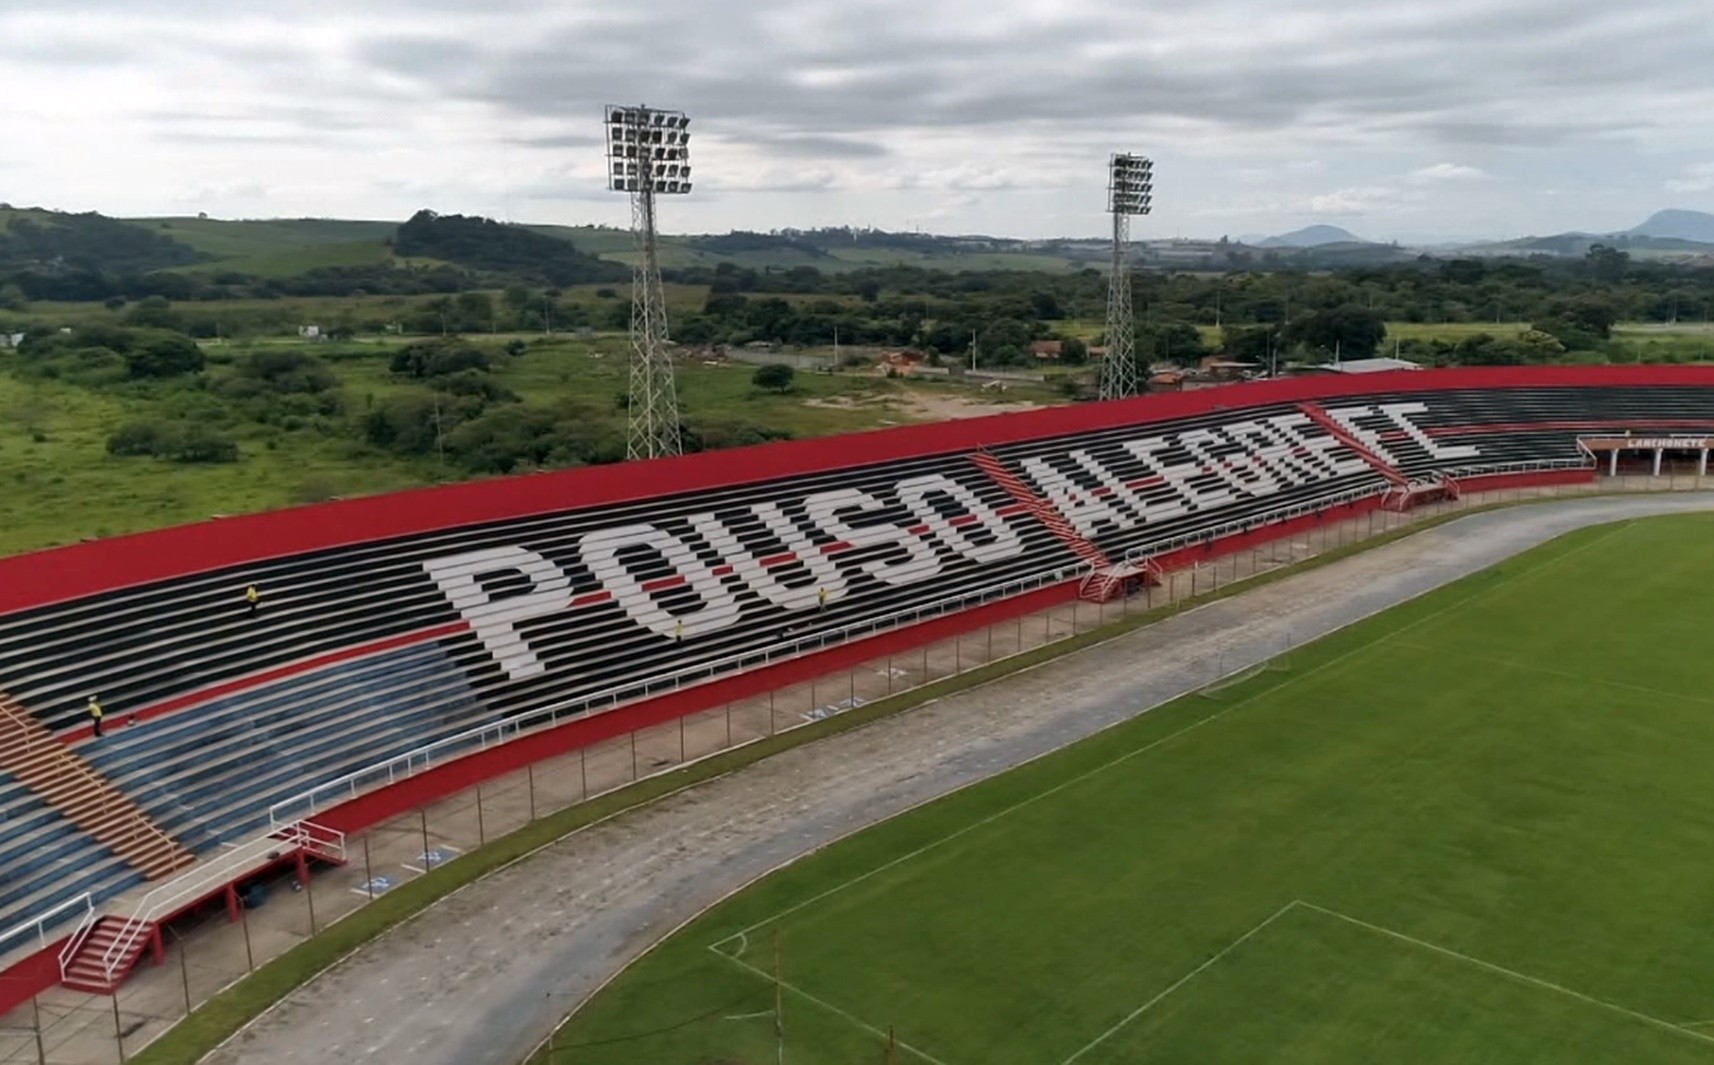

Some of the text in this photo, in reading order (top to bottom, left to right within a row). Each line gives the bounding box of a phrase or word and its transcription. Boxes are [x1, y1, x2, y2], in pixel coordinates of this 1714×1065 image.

[422, 402, 1480, 679] POUSO ALEGRE FC
